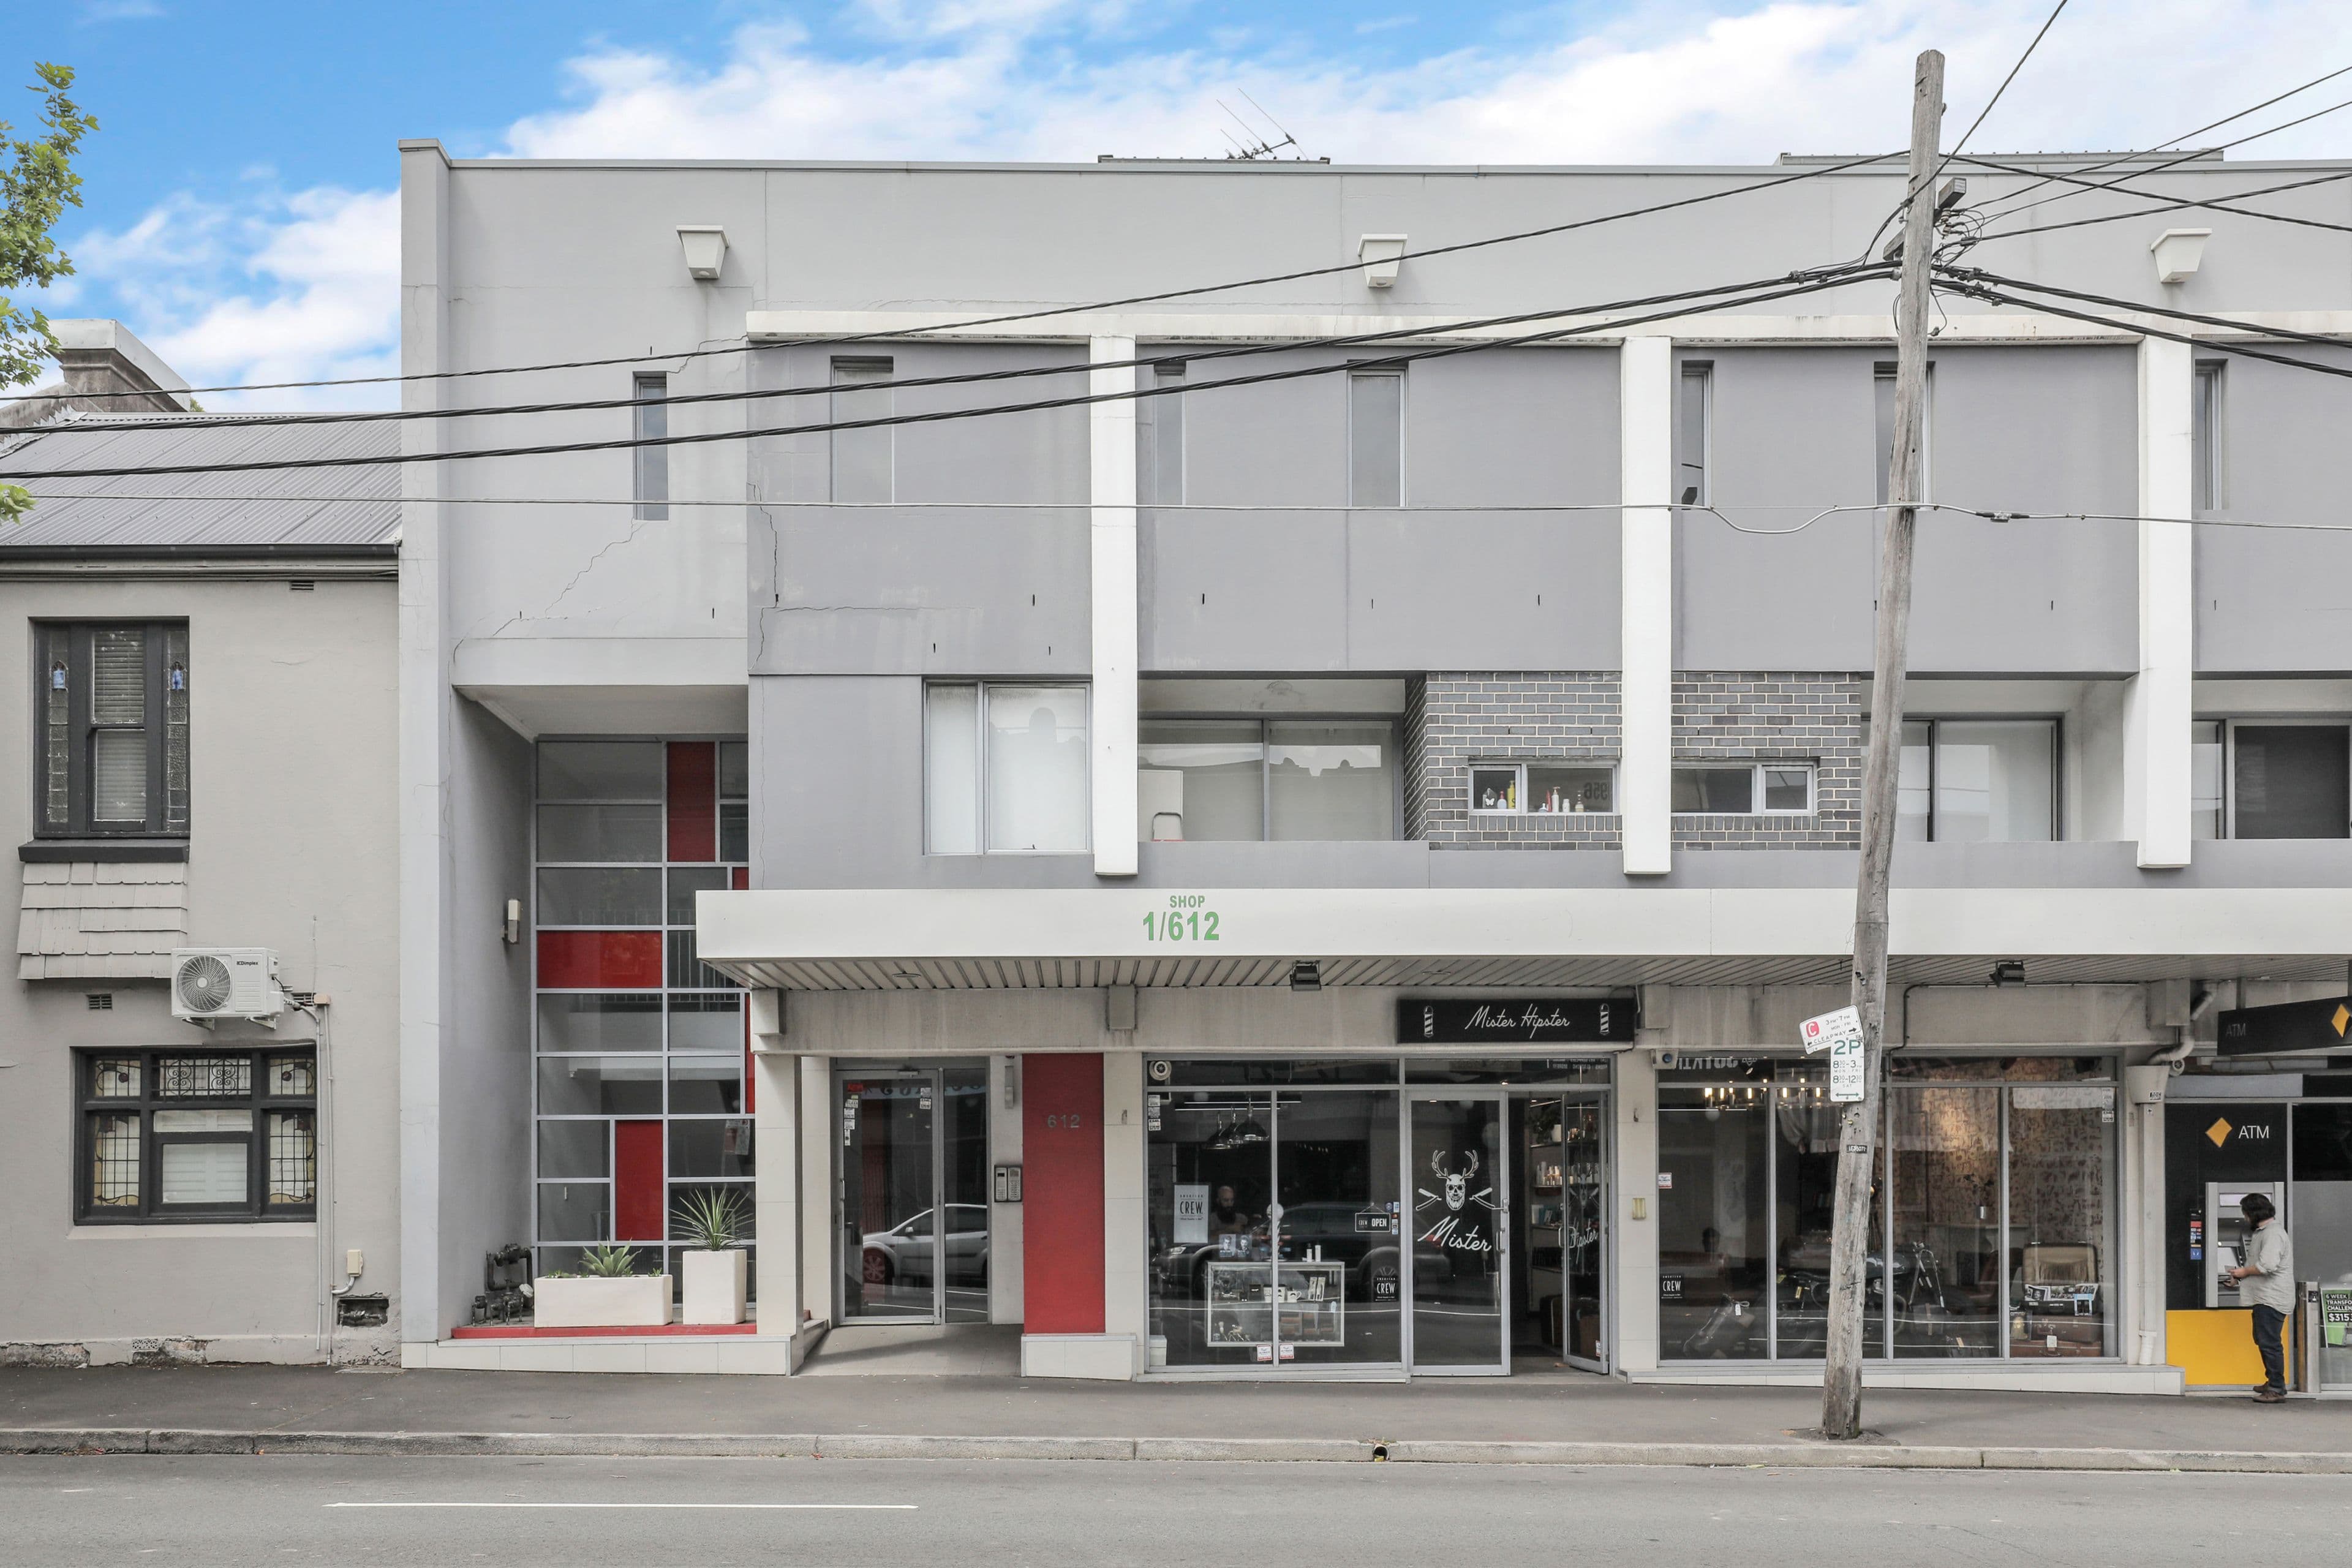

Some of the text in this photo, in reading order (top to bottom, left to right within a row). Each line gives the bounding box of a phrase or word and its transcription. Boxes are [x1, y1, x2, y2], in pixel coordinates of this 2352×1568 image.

[1169, 895, 1205, 908] SHOP
[1143, 911, 1219, 941] 1/612
[1464, 1003, 1570, 1039] Mister Hipster
[2225, 1023, 2246, 1038] ATM
[1833, 1039, 1861, 1055] 2P
[1047, 1114, 1080, 1128] 612
[2238, 1125, 2269, 1139] ATM
[1180, 1201, 1203, 1214] CREW
[1371, 1218, 1387, 1227] OPEN
[1417, 1216, 1492, 1251] Mister
[1570, 1216, 1598, 1264] Hipster
[1377, 1283, 1395, 1294] CREW
[1662, 1280, 1681, 1292] CREW
